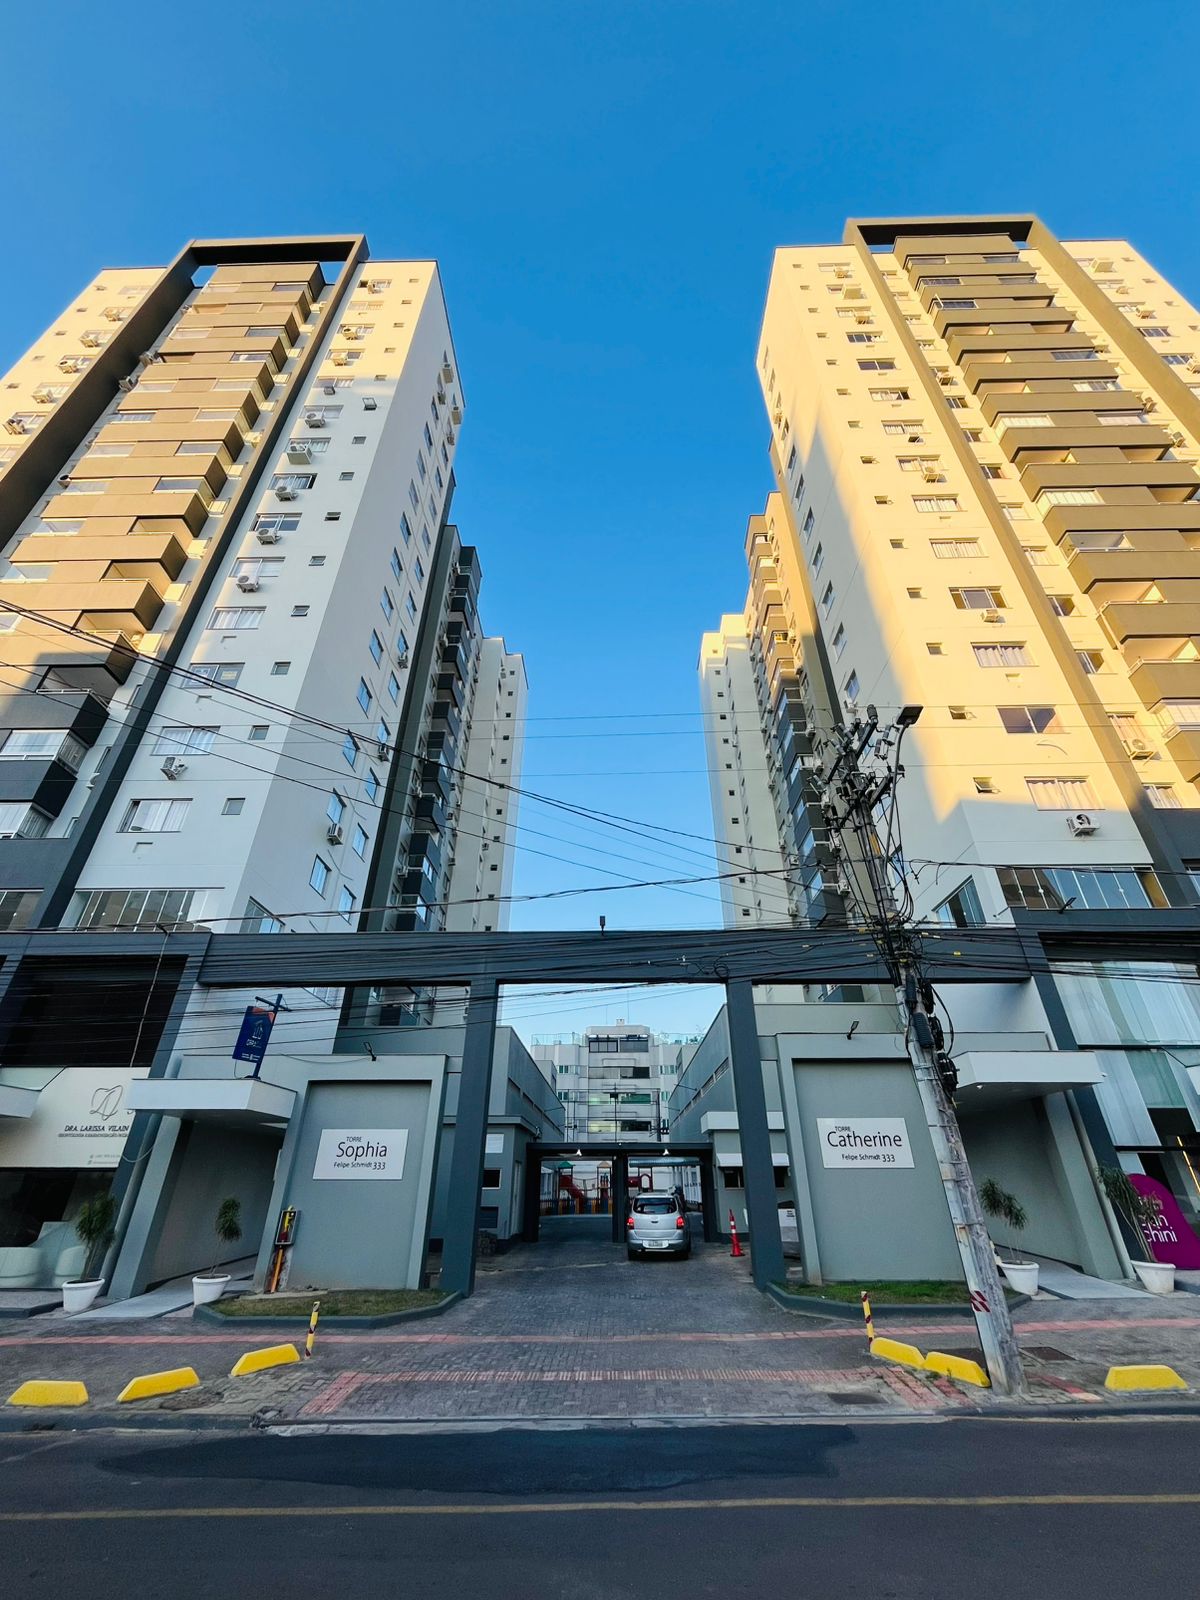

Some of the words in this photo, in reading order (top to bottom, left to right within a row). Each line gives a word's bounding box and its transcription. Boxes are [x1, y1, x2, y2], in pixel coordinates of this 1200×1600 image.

[828, 1131, 902, 1147] Catherine
[336, 1141, 387, 1161] Sophia
[882, 1154, 895, 1162] 333
[373, 1162, 386, 1170] 333
